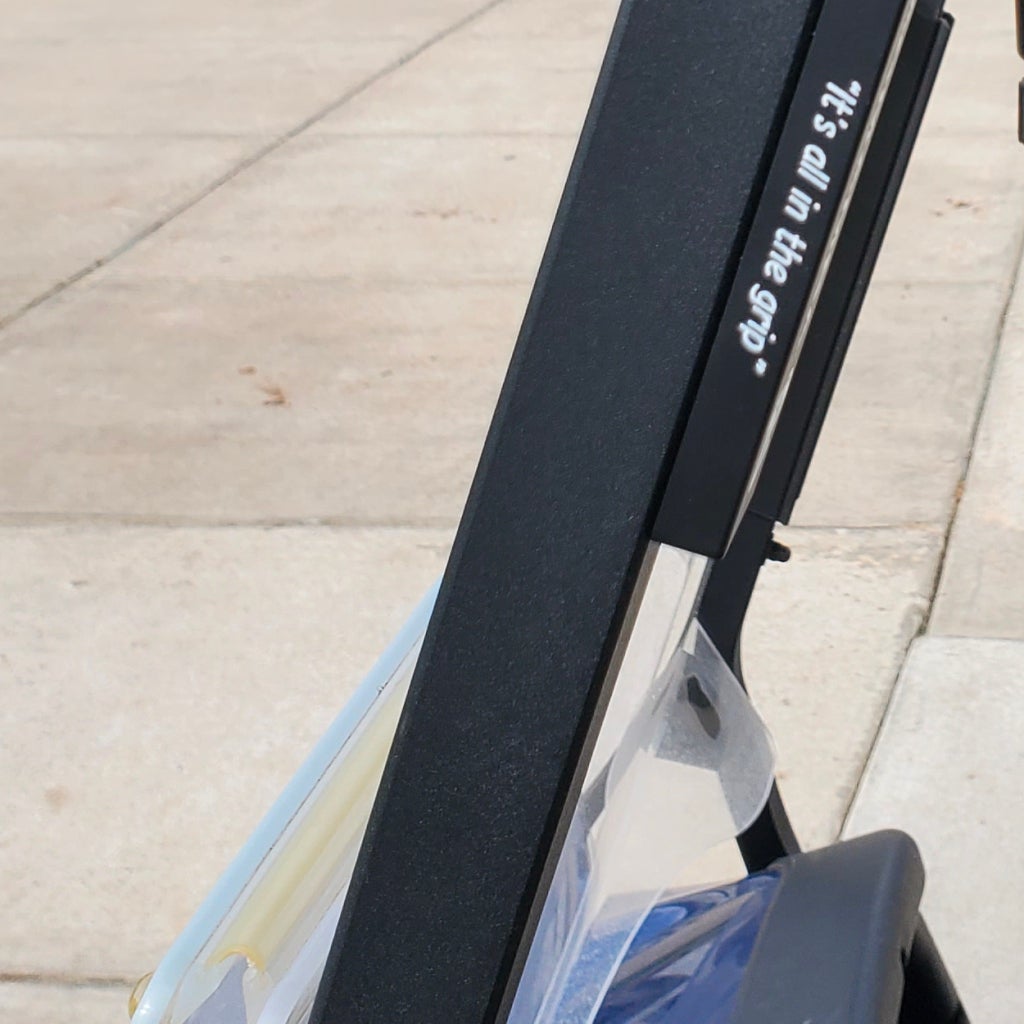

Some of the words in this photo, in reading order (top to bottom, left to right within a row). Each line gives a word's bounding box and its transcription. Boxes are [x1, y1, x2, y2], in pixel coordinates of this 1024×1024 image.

[796, 143, 831, 191] all
[784, 186, 821, 222] in
[763, 227, 808, 285] the
